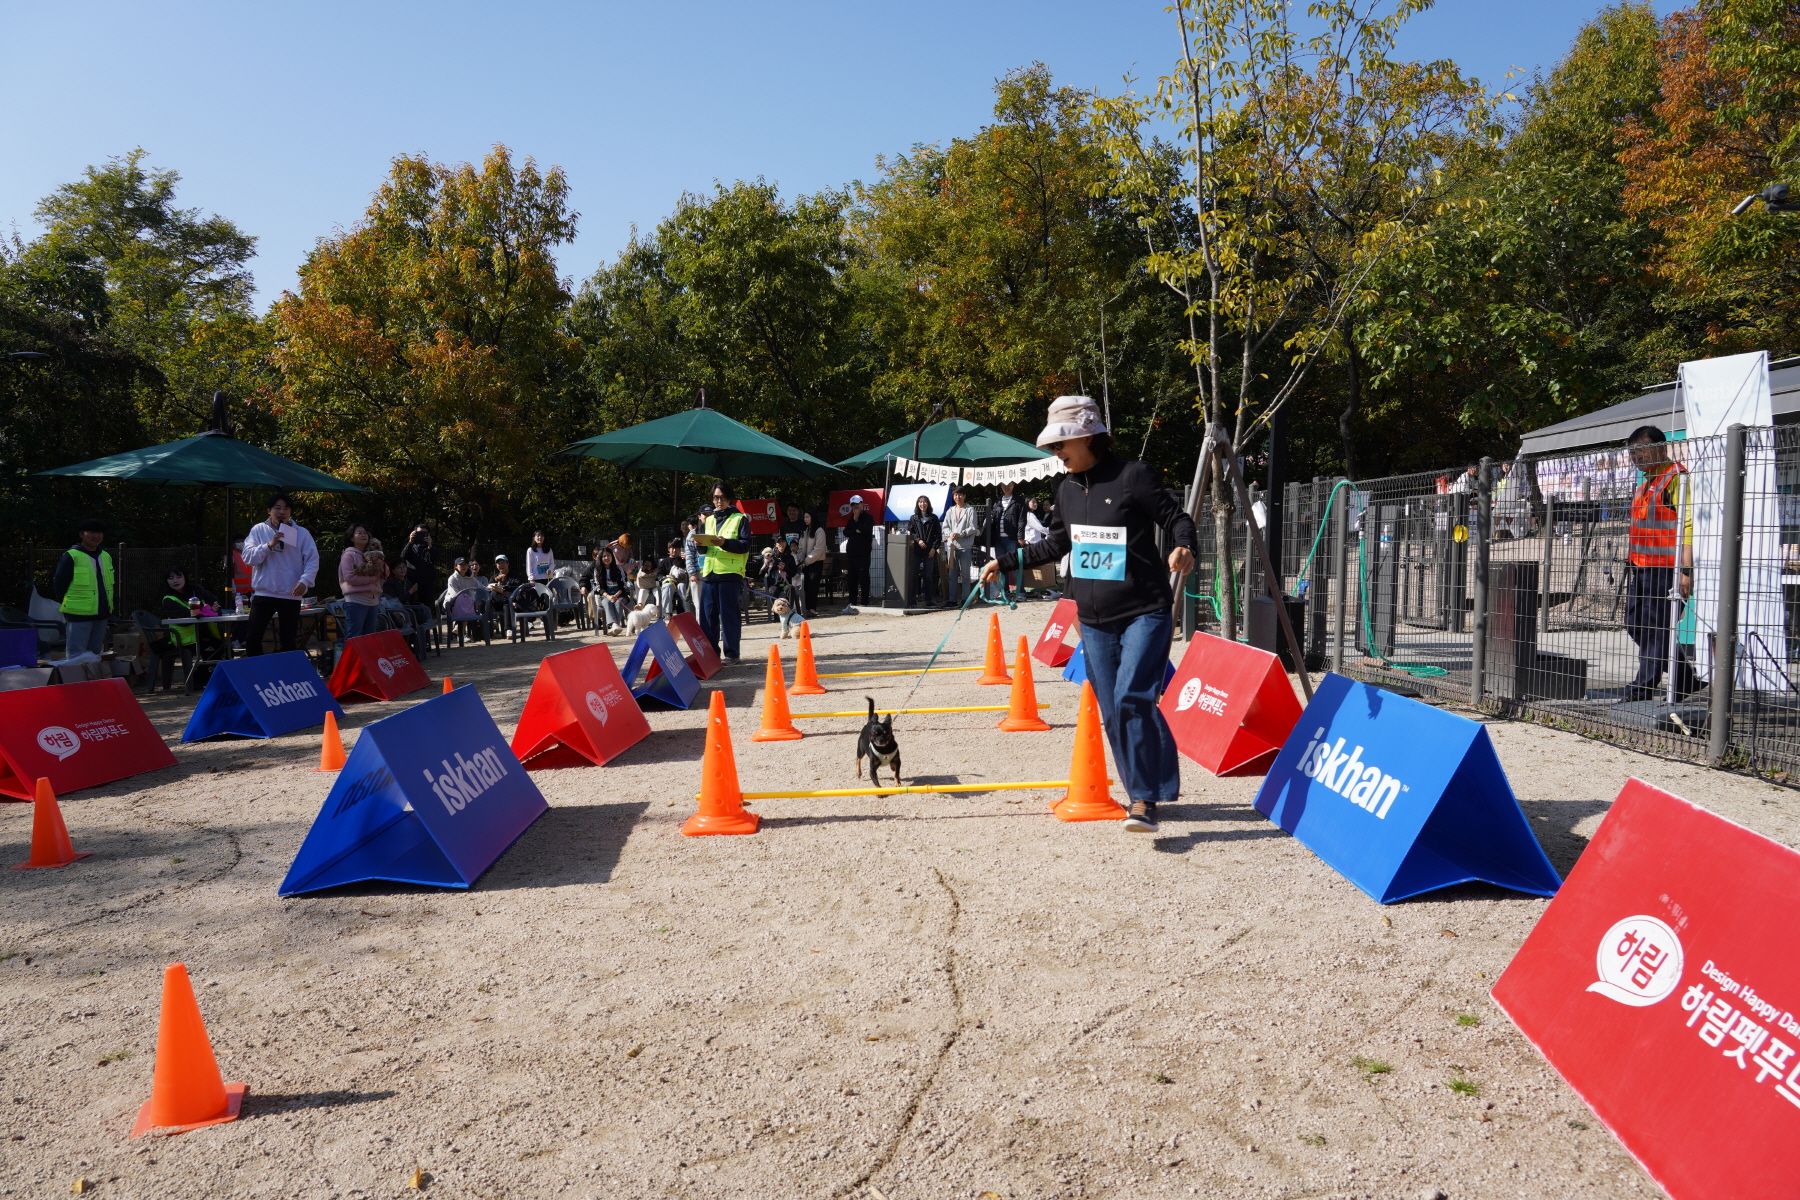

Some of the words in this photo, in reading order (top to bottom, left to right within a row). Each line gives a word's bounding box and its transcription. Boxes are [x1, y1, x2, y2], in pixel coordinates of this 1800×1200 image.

[768, 506, 775, 519] 2
[1100, 532, 1119, 540] 운동회
[1080, 551, 1114, 570] 204
[254, 680, 319, 708] iskhan
[43, 731, 74, 749] 하림
[80, 724, 130, 742] 하림펫푸드
[423, 747, 508, 817] iskhan
[1296, 726, 1402, 820] iskhan
[1616, 929, 1669, 990] 하림
[1701, 959, 1741, 994] Design
[1738, 985, 1781, 1023] Happy
